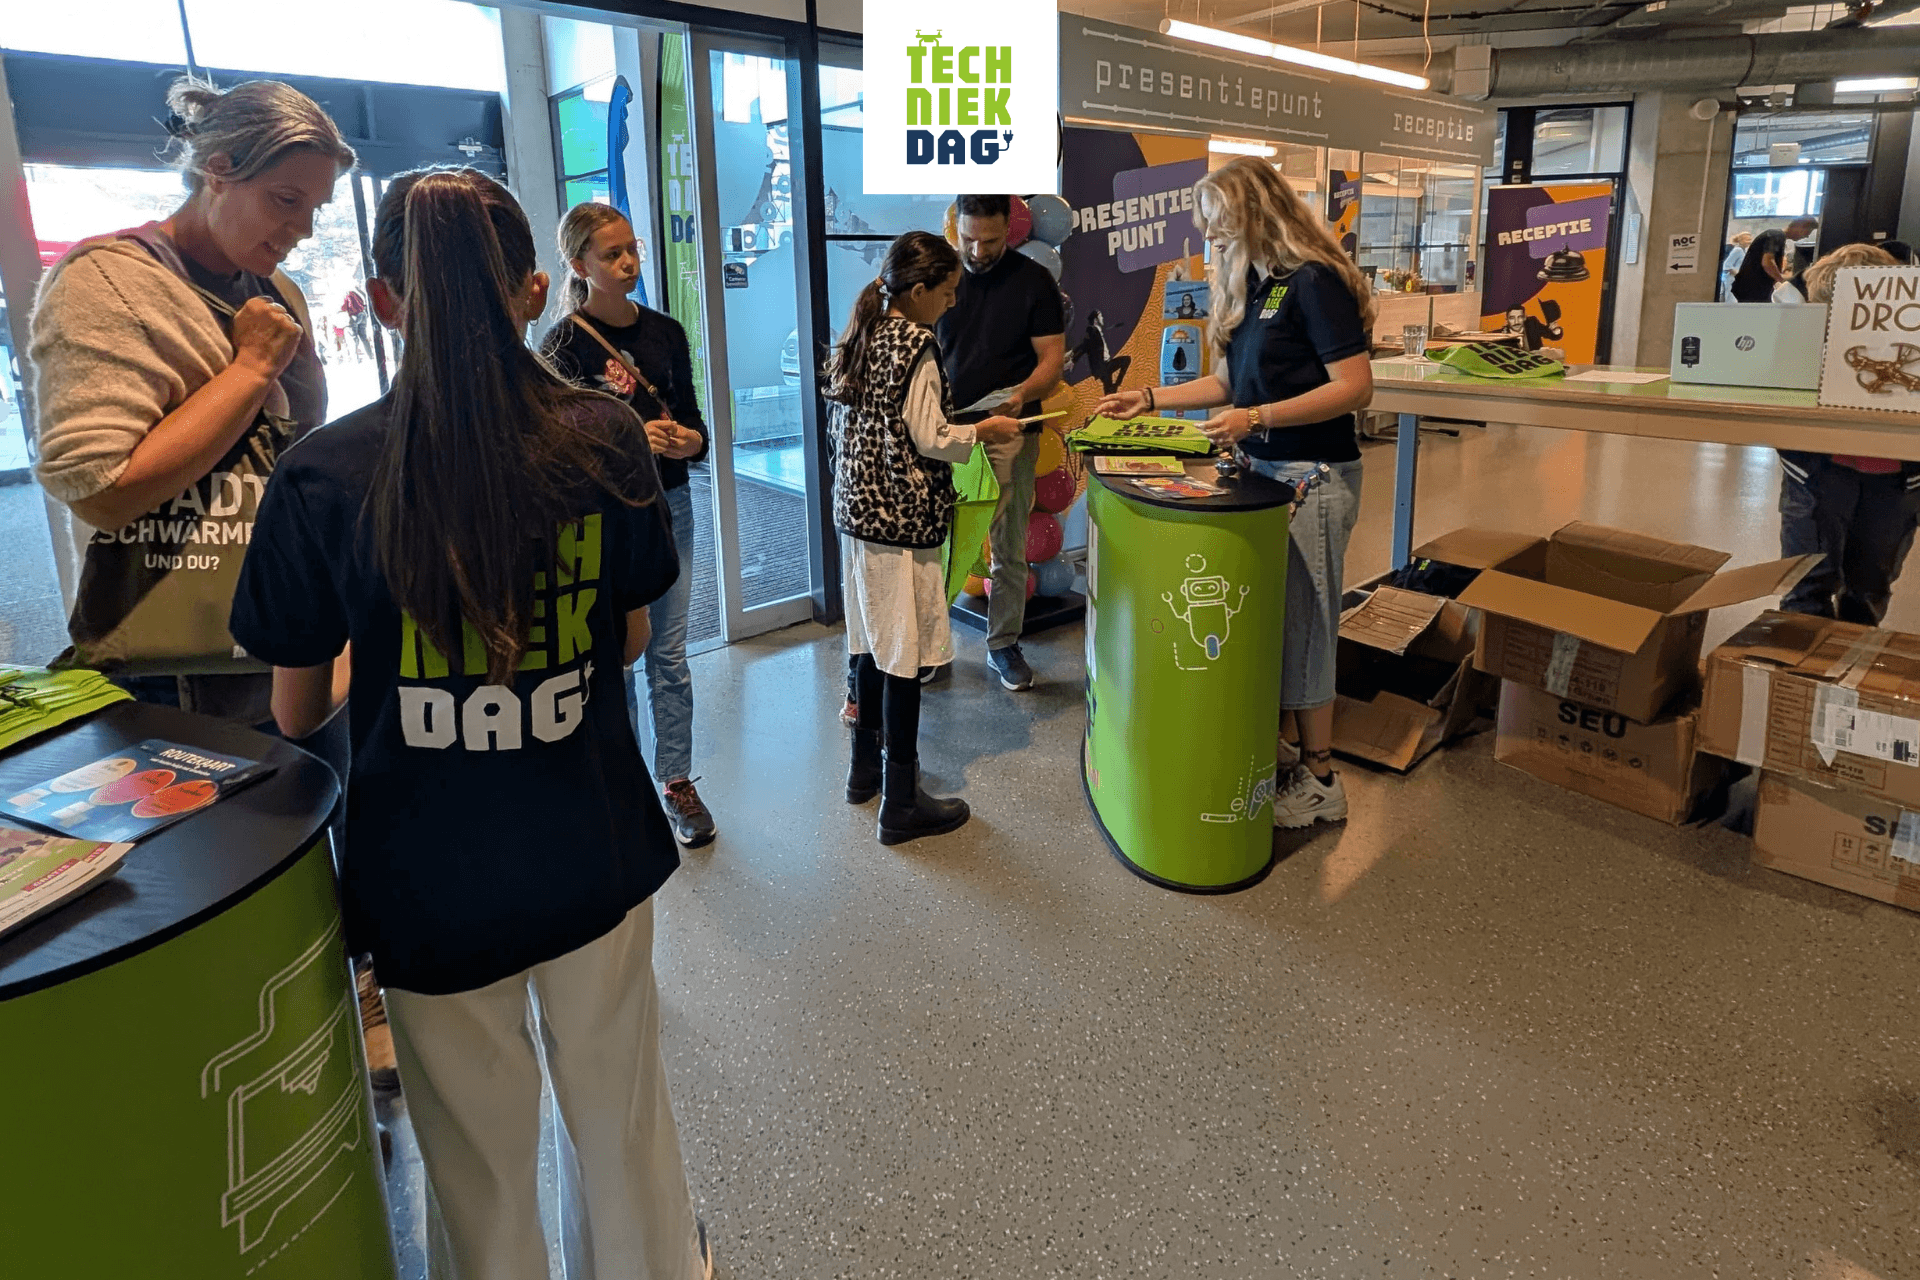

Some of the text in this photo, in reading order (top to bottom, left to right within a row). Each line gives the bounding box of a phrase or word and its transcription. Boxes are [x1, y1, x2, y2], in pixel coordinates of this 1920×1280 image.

[1096, 59, 1323, 118] presentiepunt
[1393, 111, 1474, 143] receptie
[667, 143, 692, 176] TE
[670, 214, 695, 244] DA
[1107, 219, 1168, 257] PUNT
[1498, 217, 1593, 247] RECEPTIE
[1673, 236, 1696, 247] ROC
[1854, 276, 1919, 301] WIN
[1498, 354, 1556, 375] DAG
[144, 553, 221, 571] UND DU?
[397, 668, 584, 752] DAG
[1557, 701, 1628, 739] SEU
